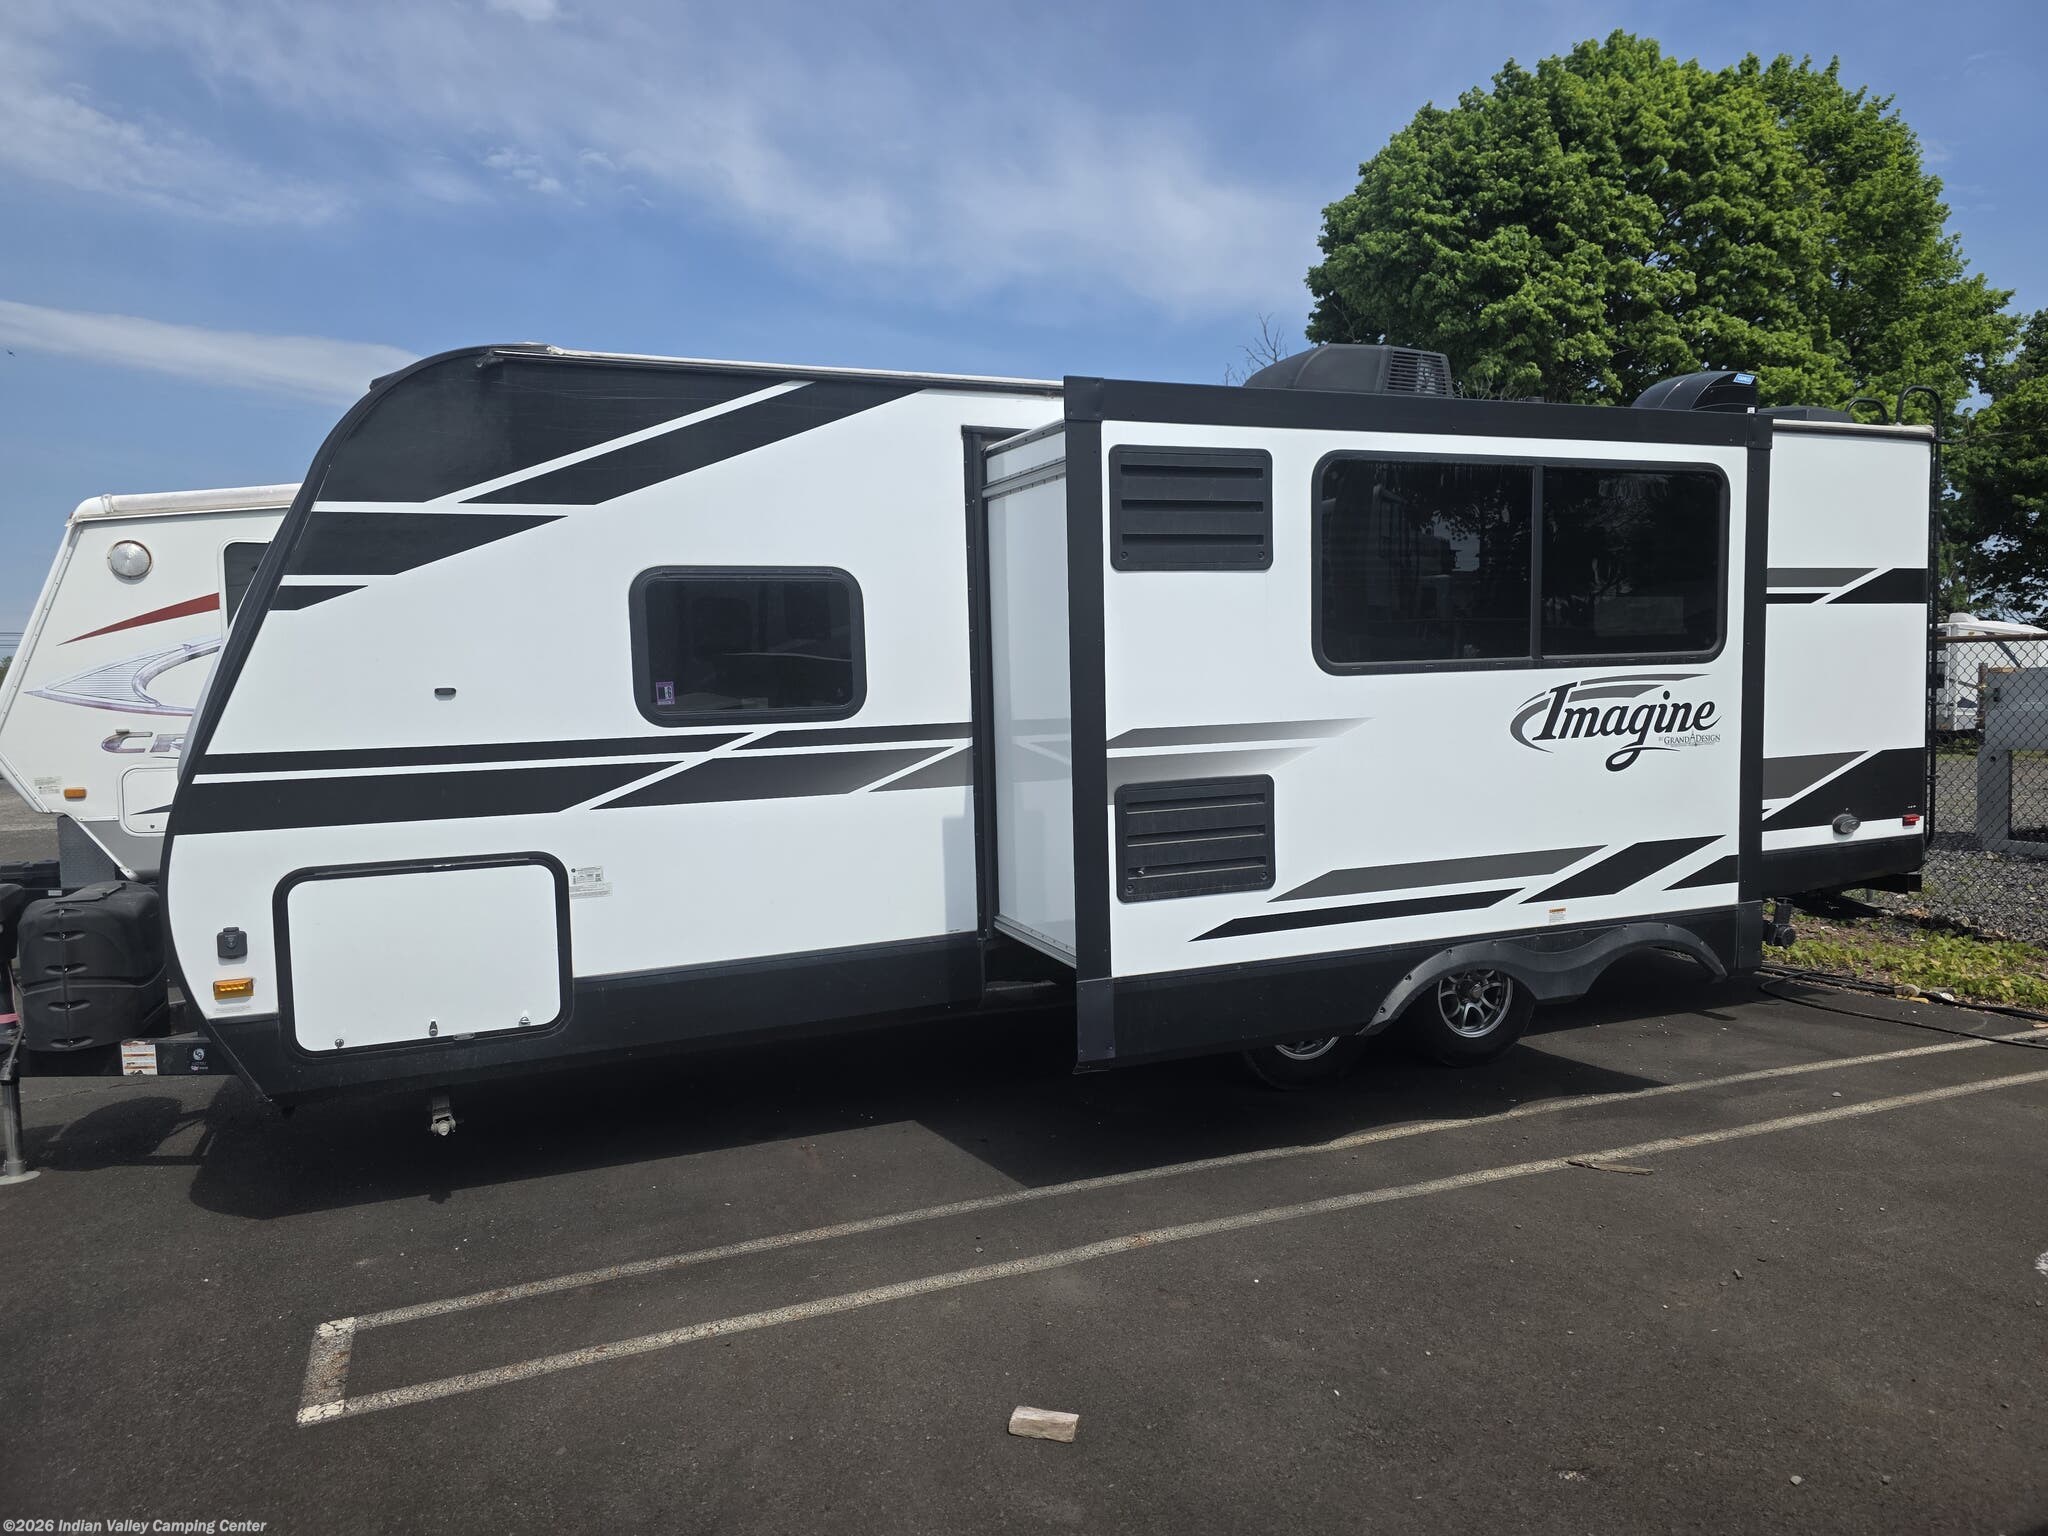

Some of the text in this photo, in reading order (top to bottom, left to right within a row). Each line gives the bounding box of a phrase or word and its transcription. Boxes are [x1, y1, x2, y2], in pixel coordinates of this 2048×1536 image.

[1532, 682, 1722, 771] Imagine
[1664, 736, 1690, 745] GRAND
[1696, 734, 1721, 743] DESIGN
